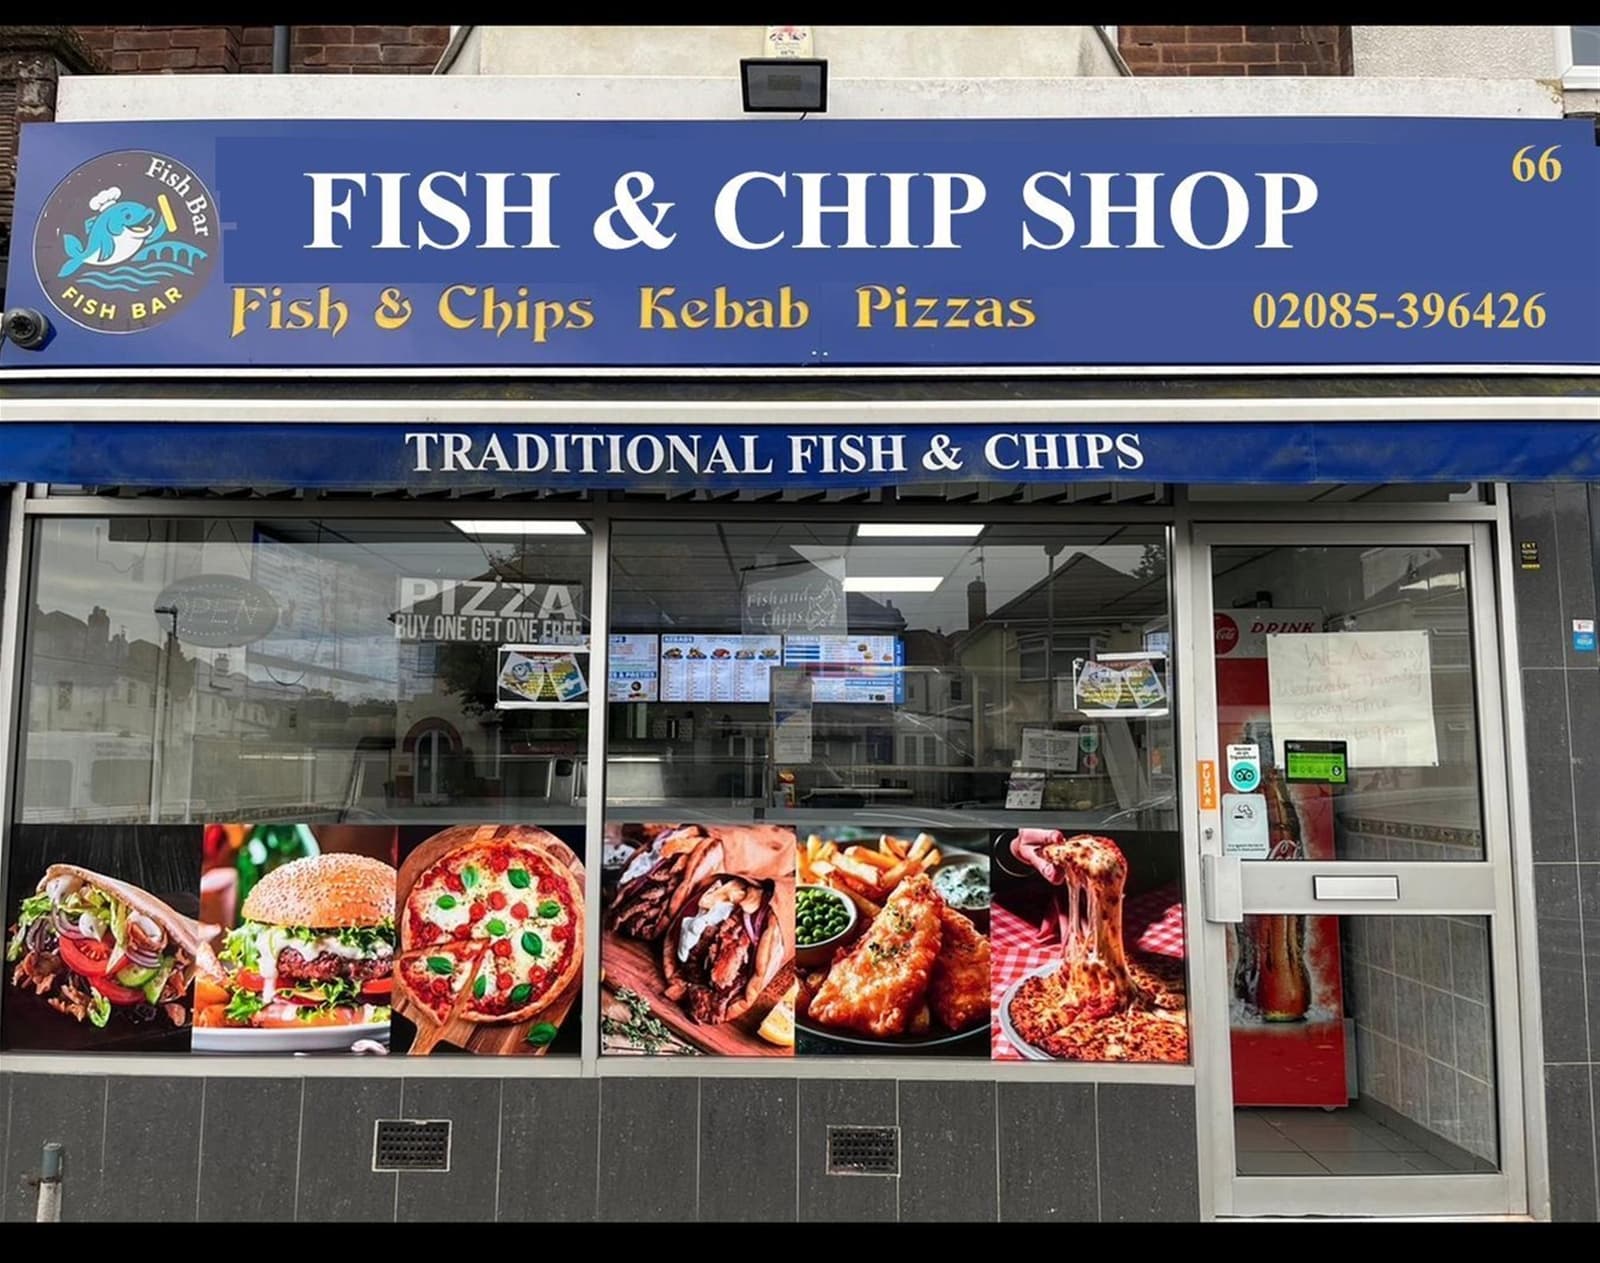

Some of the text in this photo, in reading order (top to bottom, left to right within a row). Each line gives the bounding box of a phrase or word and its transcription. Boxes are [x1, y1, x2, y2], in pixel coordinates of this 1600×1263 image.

[1512, 146, 1562, 182] 66
[145, 157, 209, 237] Fish Bar
[304, 172, 1319, 250] FISH & CHIP SHOP
[61, 286, 183, 319] FISH BAR
[231, 284, 1037, 343] Fish & Chips Kebab Pizzas
[1253, 292, 1547, 330] 02085-396426
[405, 432, 1144, 475] TRADITIONAL FISH & CHIPS
[400, 577, 577, 620] PIZZA
[395, 614, 583, 643] BUY ONE GET ONE FREE
[1250, 621, 1315, 634] DRINK
